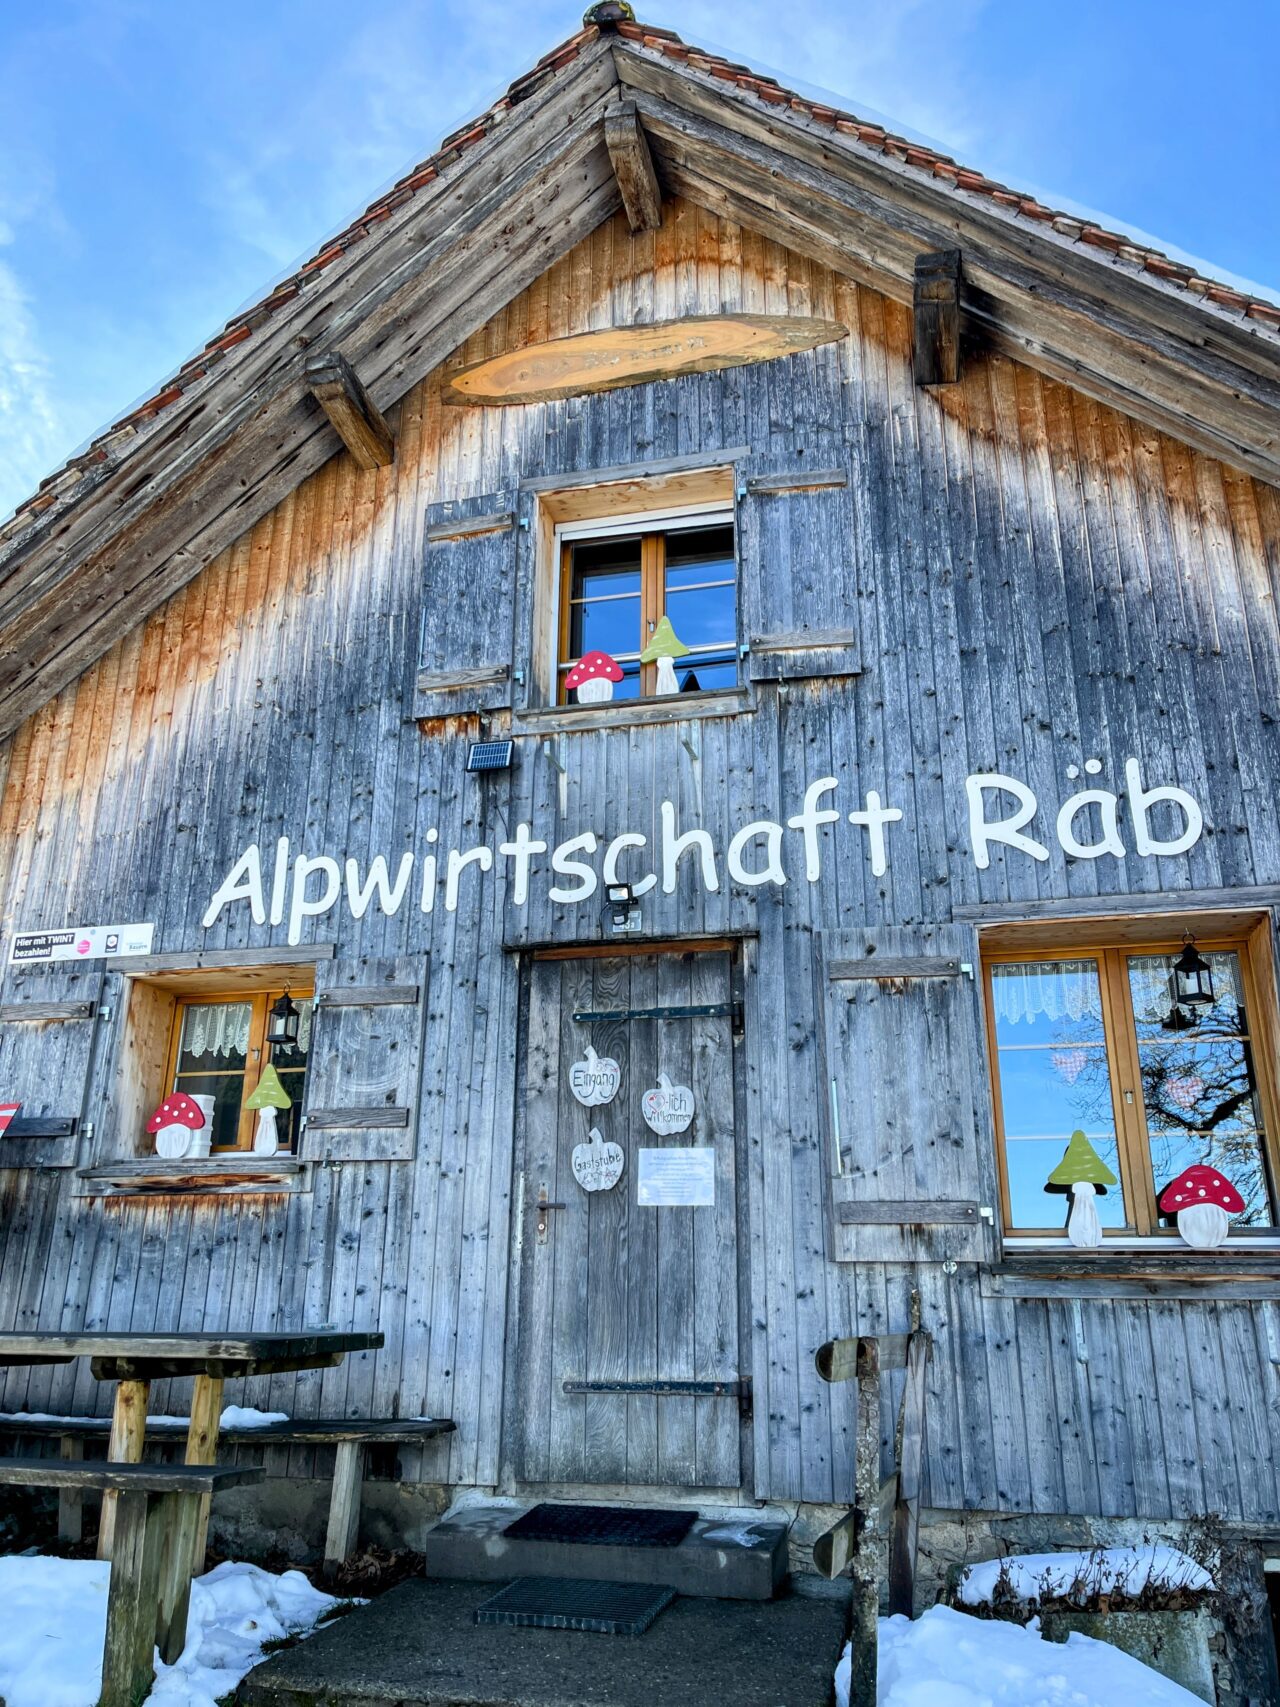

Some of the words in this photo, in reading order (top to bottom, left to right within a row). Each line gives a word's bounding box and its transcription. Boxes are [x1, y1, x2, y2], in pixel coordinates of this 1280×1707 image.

[202, 777, 903, 946] Alpwirtschaft
[966, 758, 1203, 869] Räb
[14, 947, 51, 957] bezahlen!
[16, 938, 32, 946] Hier
[33, 936, 46, 945] mit
[47, 934, 74, 944] TWINT
[573, 1070, 616, 1099] Eingang
[574, 1148, 621, 1172] Gaststube
